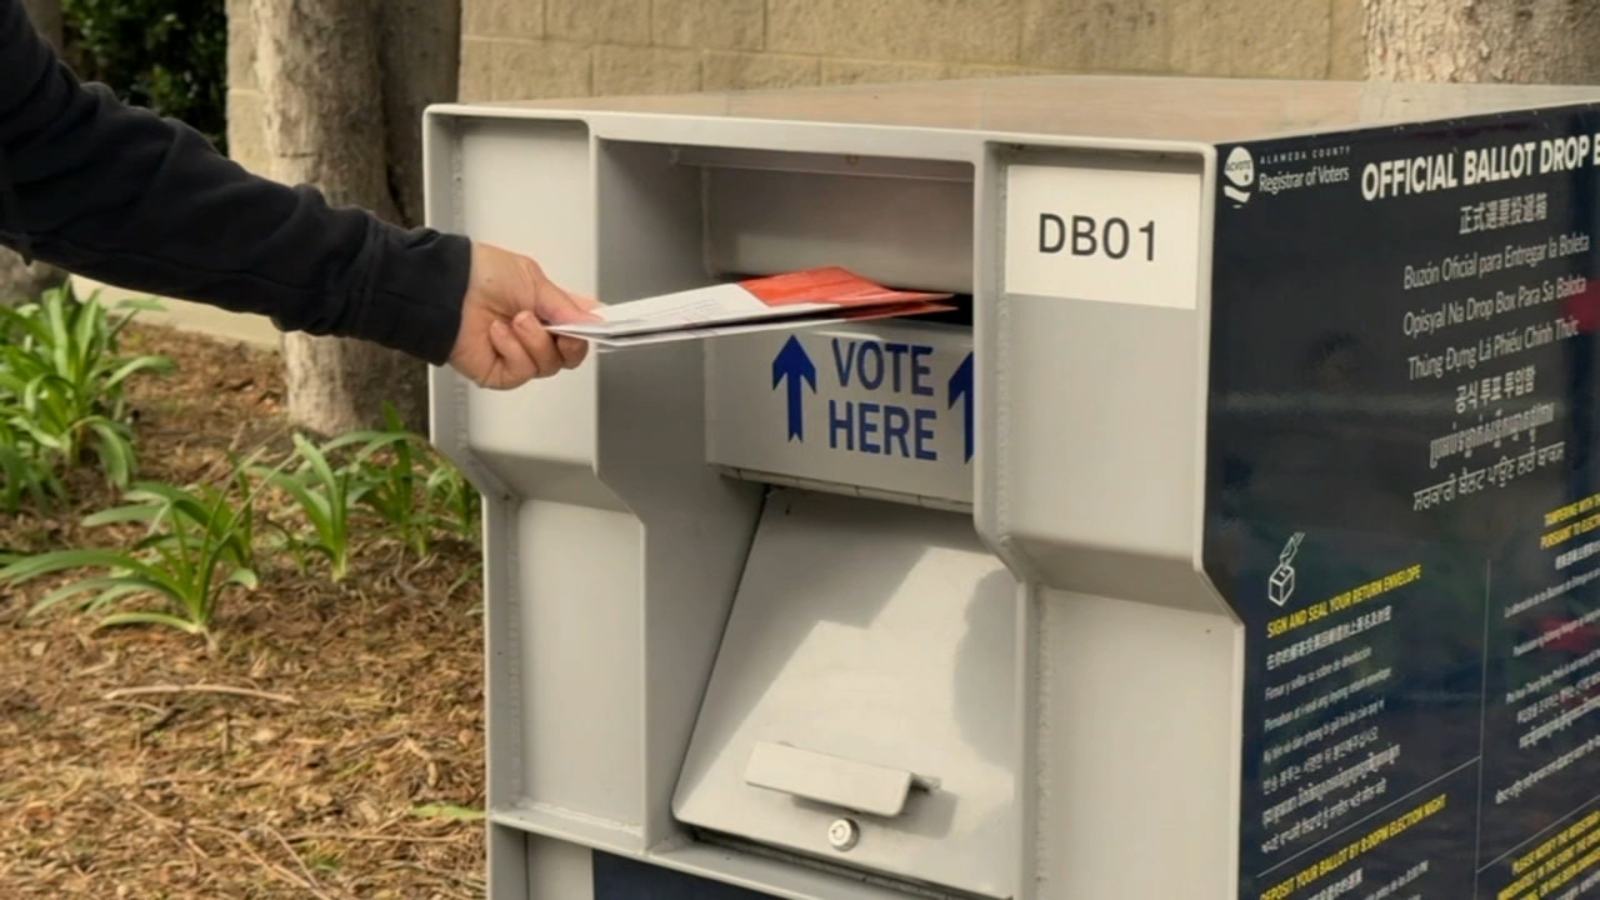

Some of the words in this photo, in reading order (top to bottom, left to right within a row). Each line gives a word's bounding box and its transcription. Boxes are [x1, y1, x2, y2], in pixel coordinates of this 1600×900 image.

[1259, 171, 1304, 195] Registrar
[1305, 166, 1318, 186] of
[1317, 164, 1350, 184] Voters
[1260, 151, 1307, 165] ALAMEDA
[1312, 145, 1351, 159] COUNTY
[1361, 153, 1458, 201] OFFICIAL
[1463, 142, 1536, 185] BALLOT
[1540, 135, 1590, 174] DROP
[1039, 213, 1154, 262] DB01
[1403, 262, 1440, 290] Buzón
[1442, 252, 1478, 281] Oficial
[1479, 253, 1503, 278] para
[1505, 244, 1547, 268] Entregar
[1549, 236, 1558, 258] la
[1559, 232, 1590, 257] Boleta
[1403, 303, 1446, 338] Opisyal
[1448, 302, 1464, 325] Na
[1467, 297, 1494, 320] Drop
[1496, 291, 1516, 314] Box
[1518, 286, 1541, 308] Para
[1542, 280, 1554, 302] Sa
[1556, 274, 1587, 299] Balota
[832, 338, 934, 396] VOTE
[1407, 353, 1443, 380] Thùng
[1479, 337, 1492, 361] Lá
[1525, 323, 1554, 348] Chính
[1455, 381, 1478, 414] 공식
[1480, 376, 1502, 406] 투표
[829, 400, 937, 461] HERE
[1267, 617, 1288, 639] SIGN
[1289, 609, 1308, 629] AND
[1308, 601, 1329, 622] SEAL
[1329, 592, 1351, 612] YOUR
[1352, 580, 1383, 604] RETURN
[1384, 564, 1421, 592] ENVELOPE
[1296, 864, 1319, 888] YOUR
[1319, 847, 1348, 876] BALLOT
[1349, 840, 1361, 859] BY
[1389, 807, 1424, 837] ELECTION
[1424, 793, 1447, 817] NIGHT
